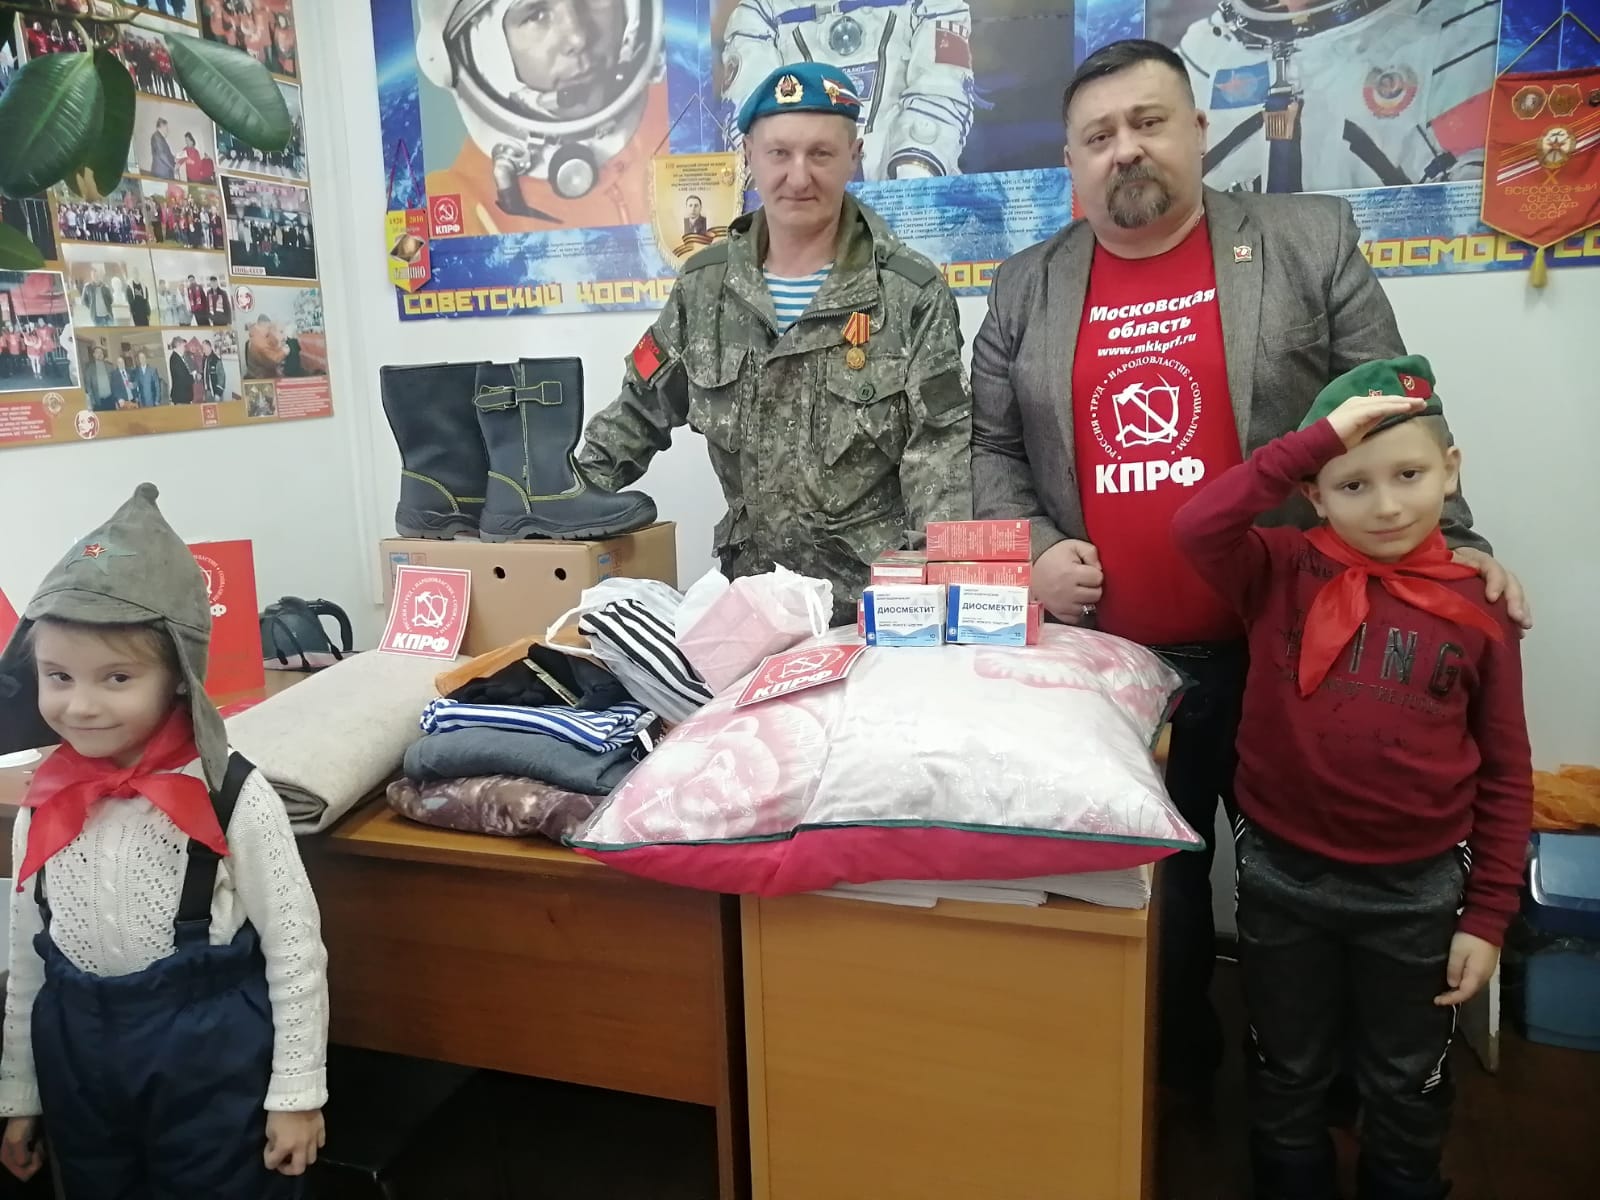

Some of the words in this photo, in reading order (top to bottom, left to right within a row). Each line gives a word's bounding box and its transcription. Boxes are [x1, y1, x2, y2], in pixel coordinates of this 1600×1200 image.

[1527, 209, 1567, 220] СССР
[435, 224, 461, 235] КПРФ
[403, 283, 563, 315] СОВЕТСКИЙ
[576, 277, 676, 306] КОСМО
[1089, 287, 1216, 324] Московская
[1107, 315, 1192, 340] область
[1096, 332, 1197, 357] www.mkkprf.ru
[1090, 385, 1106, 411] ТРУД
[1107, 356, 1191, 380] НАРОДОВЛАСТИЕ
[1177, 382, 1202, 451] СОЦИАЛИЗМ
[1095, 455, 1206, 494] КПРФ
[877, 606, 936, 615] ДИОСМЕКТИТ
[962, 603, 1025, 612] ДИОСМЕКТИТ
[391, 633, 450, 652] КПРФ
[1348, 622, 1465, 697] ING
[752, 669, 833, 700] КПРФ
